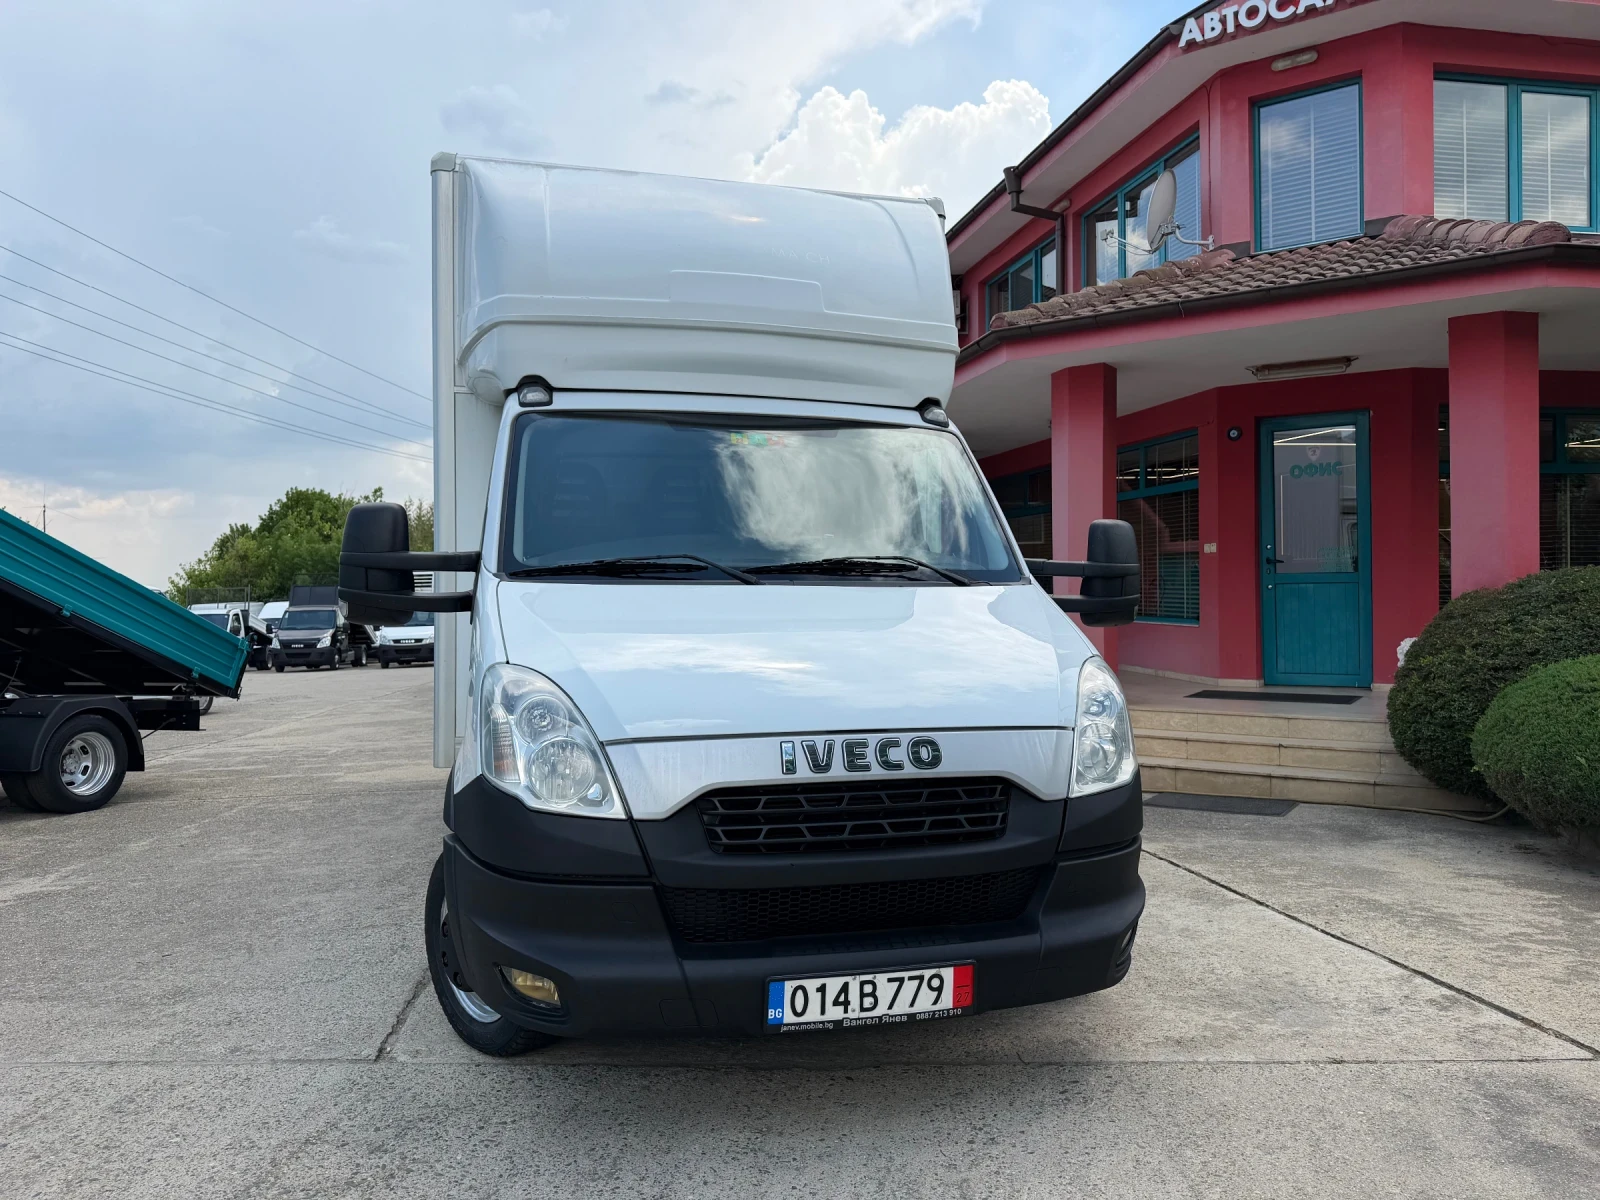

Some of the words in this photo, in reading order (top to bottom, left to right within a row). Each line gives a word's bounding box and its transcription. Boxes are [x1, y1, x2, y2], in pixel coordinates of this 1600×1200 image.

[1178, 0, 1334, 48] АВТОС
[1289, 461, 1343, 479] ОФИС
[780, 736, 943, 774] IVECO
[768, 1008, 783, 1019] BG
[916, 1012, 933, 1020] 0887
[935, 1010, 948, 1018] 213
[949, 1008, 962, 1016] 910
[780, 1022, 834, 1032] janev.mobile.bg
[843, 1017, 879, 1027] Вангел
[882, 1015, 908, 1024] Янев
